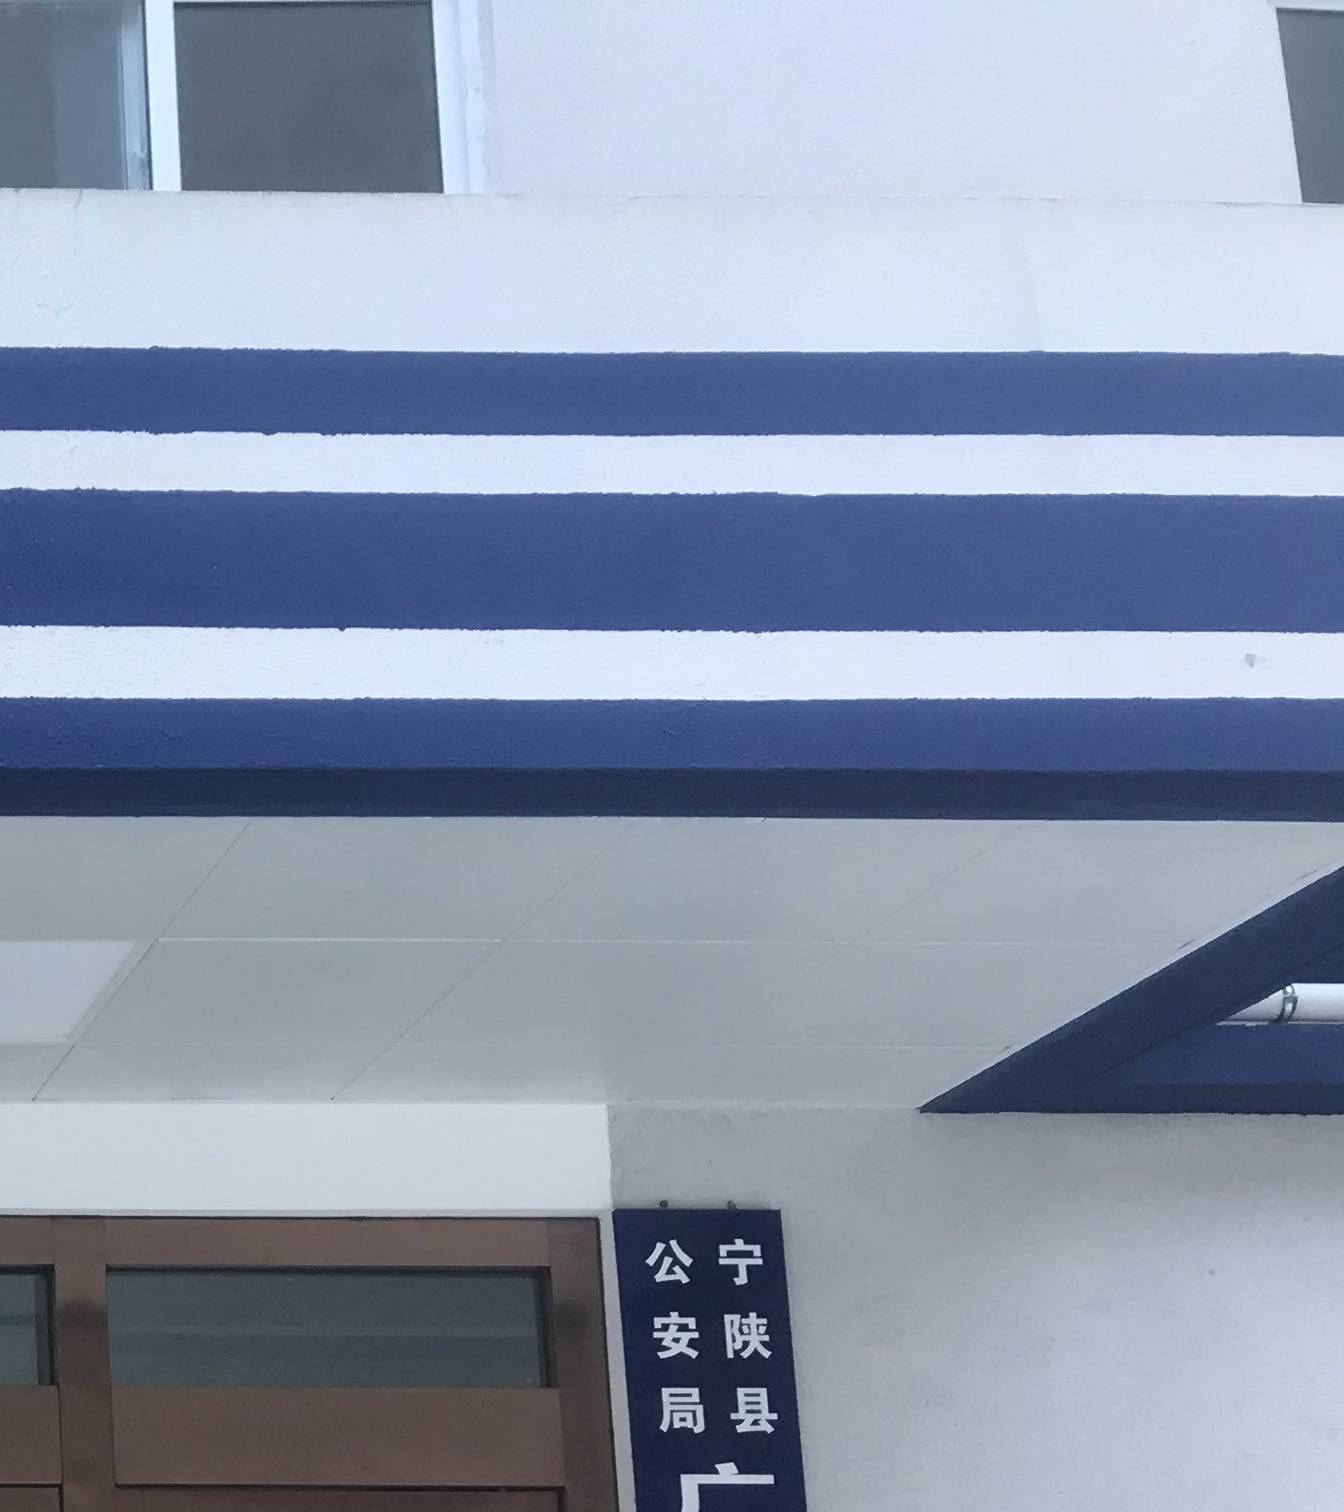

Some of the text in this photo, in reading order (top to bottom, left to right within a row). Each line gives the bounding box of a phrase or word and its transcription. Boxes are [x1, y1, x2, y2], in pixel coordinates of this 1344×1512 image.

[645, 1239, 706, 1434] 公安局
[718, 1238, 779, 1434] 宁陕县
